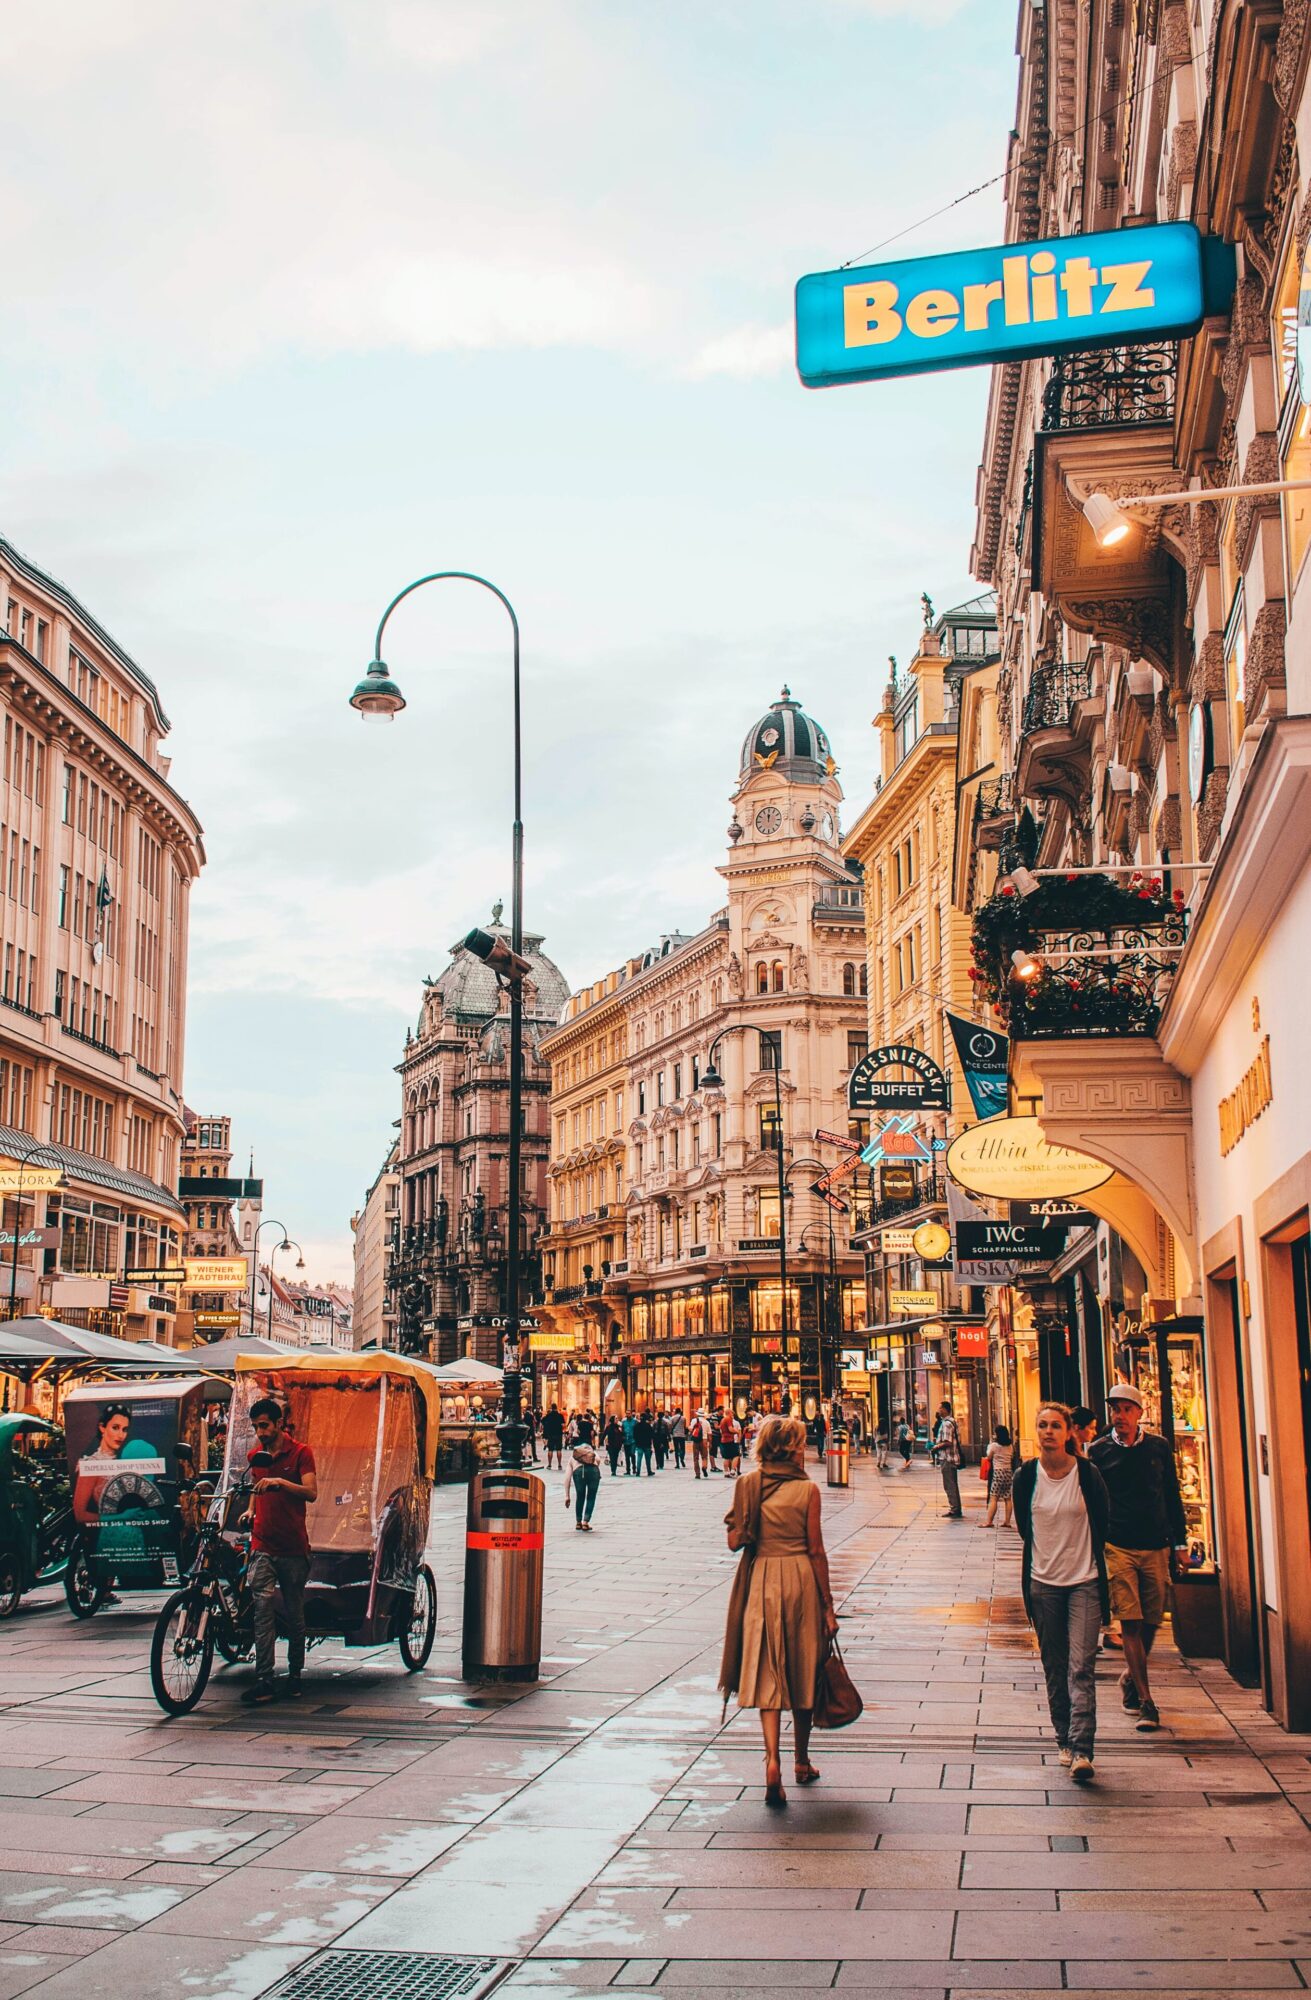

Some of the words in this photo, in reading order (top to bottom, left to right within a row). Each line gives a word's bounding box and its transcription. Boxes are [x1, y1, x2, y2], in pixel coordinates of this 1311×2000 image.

[843, 250, 1155, 349] Berlitz
[871, 1084, 925, 1096] BUFFET
[1030, 1204, 1080, 1215] BALLY
[985, 1227, 1026, 1243] IWC
[972, 1246, 1041, 1254] SCHAFFHAUSEN
[958, 1261, 1018, 1277] LISKA
[960, 1331, 985, 1342] högl
